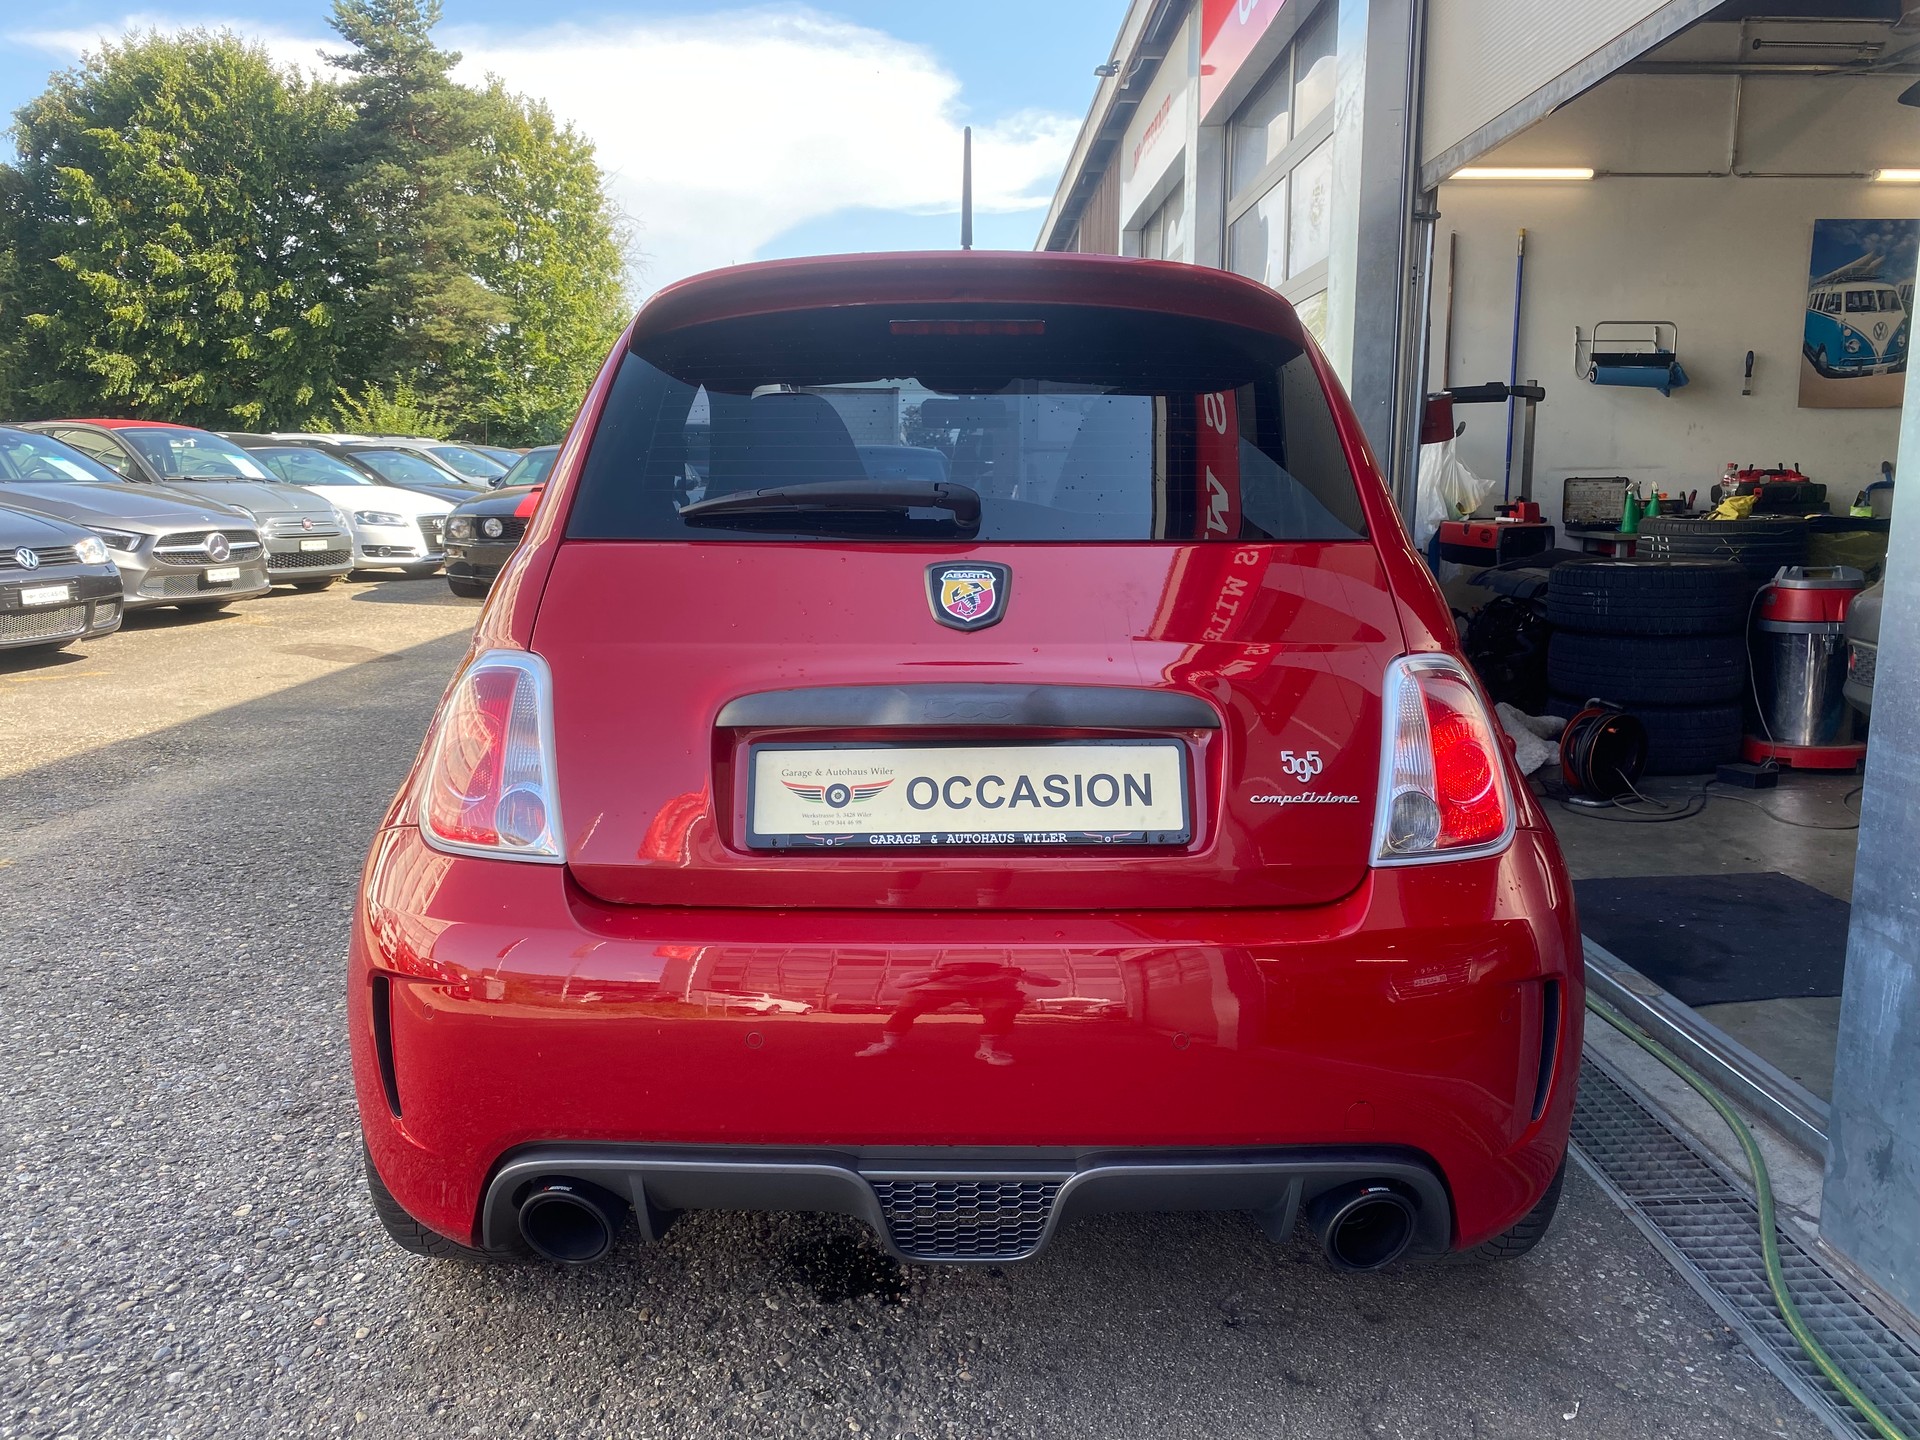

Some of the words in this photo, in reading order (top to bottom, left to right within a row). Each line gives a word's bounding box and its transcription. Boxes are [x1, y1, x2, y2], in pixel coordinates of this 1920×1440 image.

[781, 768, 812, 778] Garage
[815, 768, 823, 776] &
[826, 767, 868, 776] Autohaus
[871, 767, 894, 775] Wiler
[1280, 750, 1323, 782] 595
[905, 773, 1153, 810] OCCASION
[1250, 791, 1360, 806] competizione
[869, 834, 921, 844] GARAGE
[930, 834, 938, 844] &
[946, 833, 1015, 844] AUTOHAUS
[1023, 832, 1068, 843] WILER
